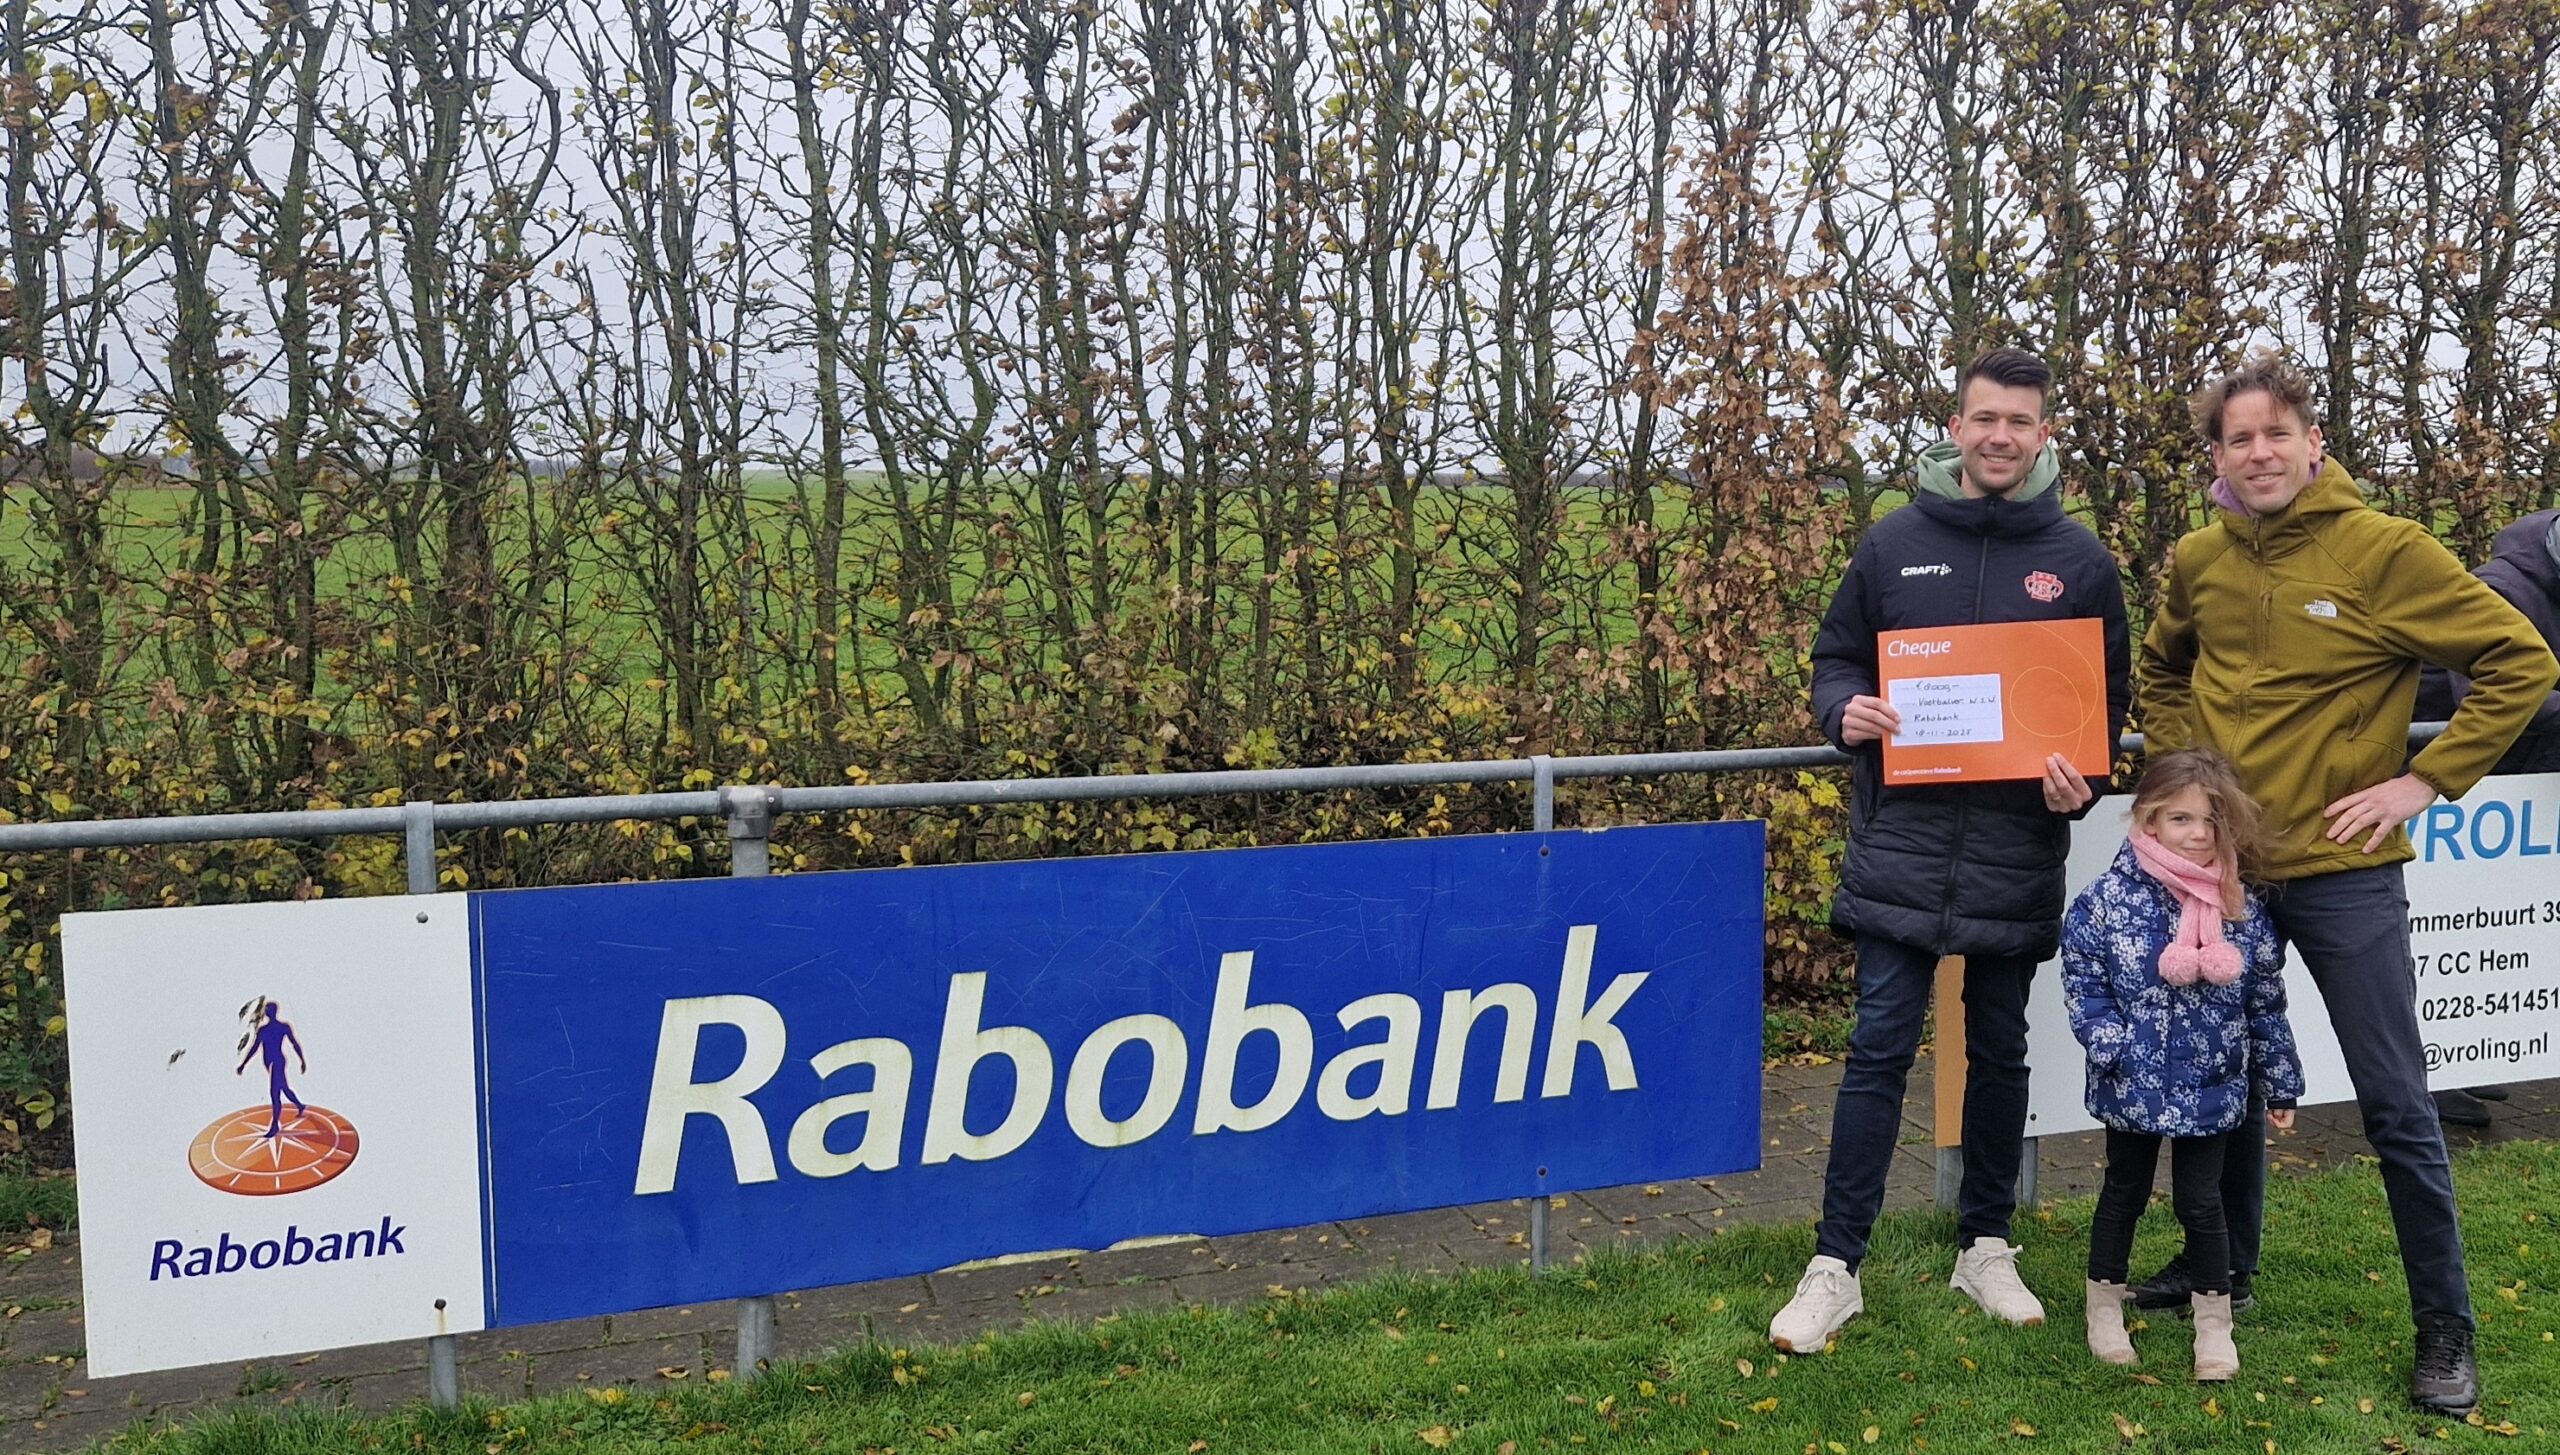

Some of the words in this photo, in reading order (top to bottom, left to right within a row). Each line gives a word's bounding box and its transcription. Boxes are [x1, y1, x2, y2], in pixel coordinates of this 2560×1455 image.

[1901, 565, 1940, 577] CRAFT
[1887, 640, 1952, 658] Cheque
[1914, 712, 1959, 722] Rabobank
[2407, 800, 2560, 862] ROL
[2438, 951, 2471, 975] CC
[2480, 949, 2529, 972] Hem
[2422, 987, 2559, 1021] 0228-541451
[633, 924, 1652, 1195] Rabobank
[149, 1216, 407, 1281] Rabobank
